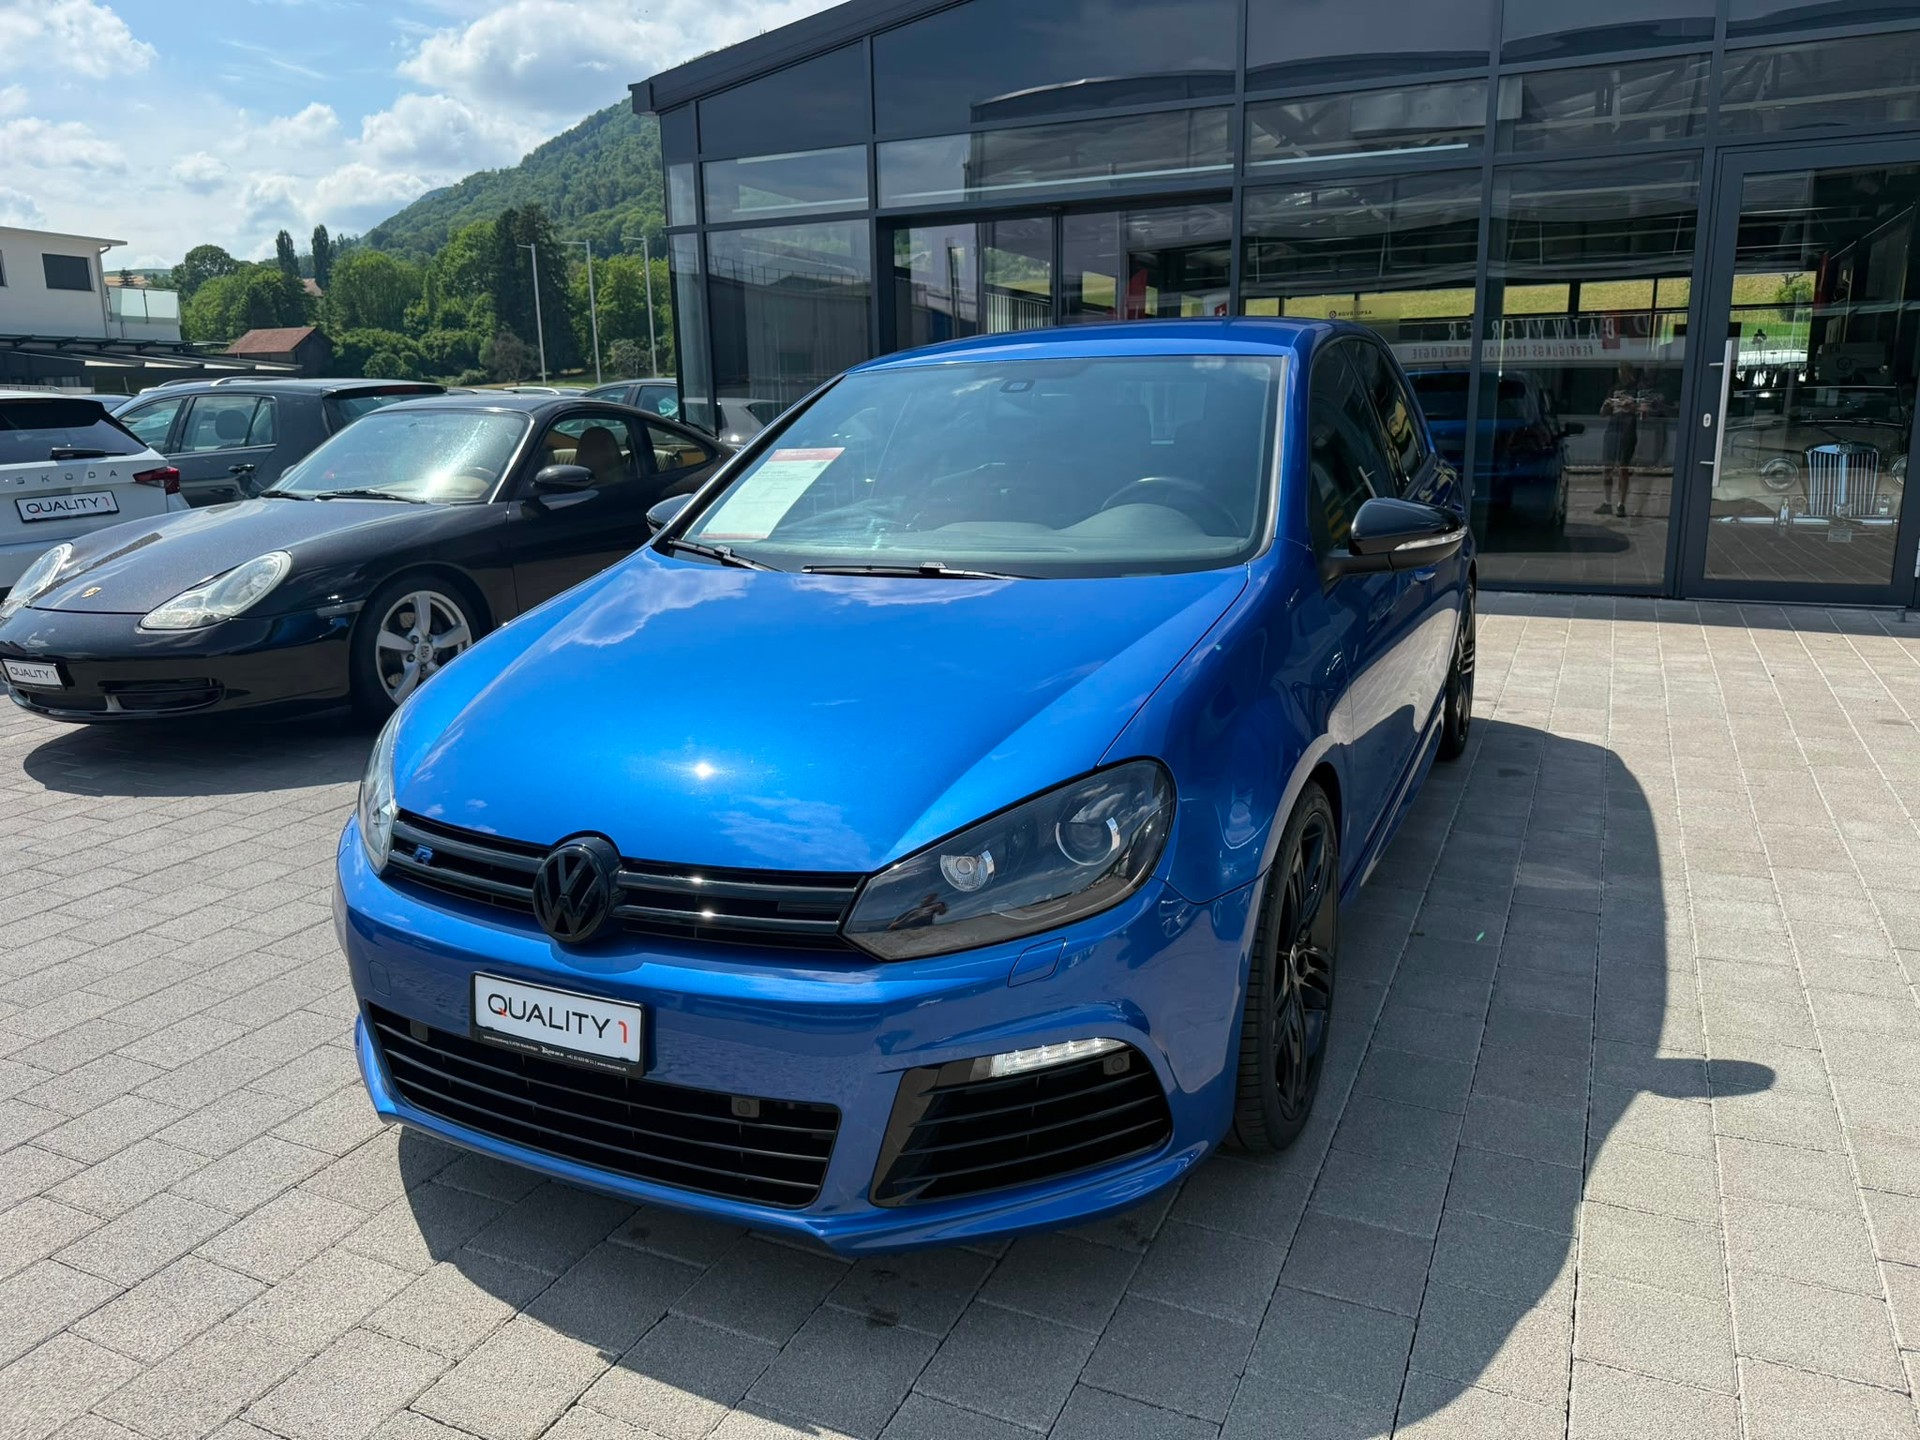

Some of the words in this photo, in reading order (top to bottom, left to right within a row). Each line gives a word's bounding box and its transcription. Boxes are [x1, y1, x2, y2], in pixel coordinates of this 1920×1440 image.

[26, 497, 98, 514] QUALITY
[10, 666, 49, 679] QUALITY
[487, 992, 612, 1040] QUALITY
[617, 1019, 629, 1044] 1
